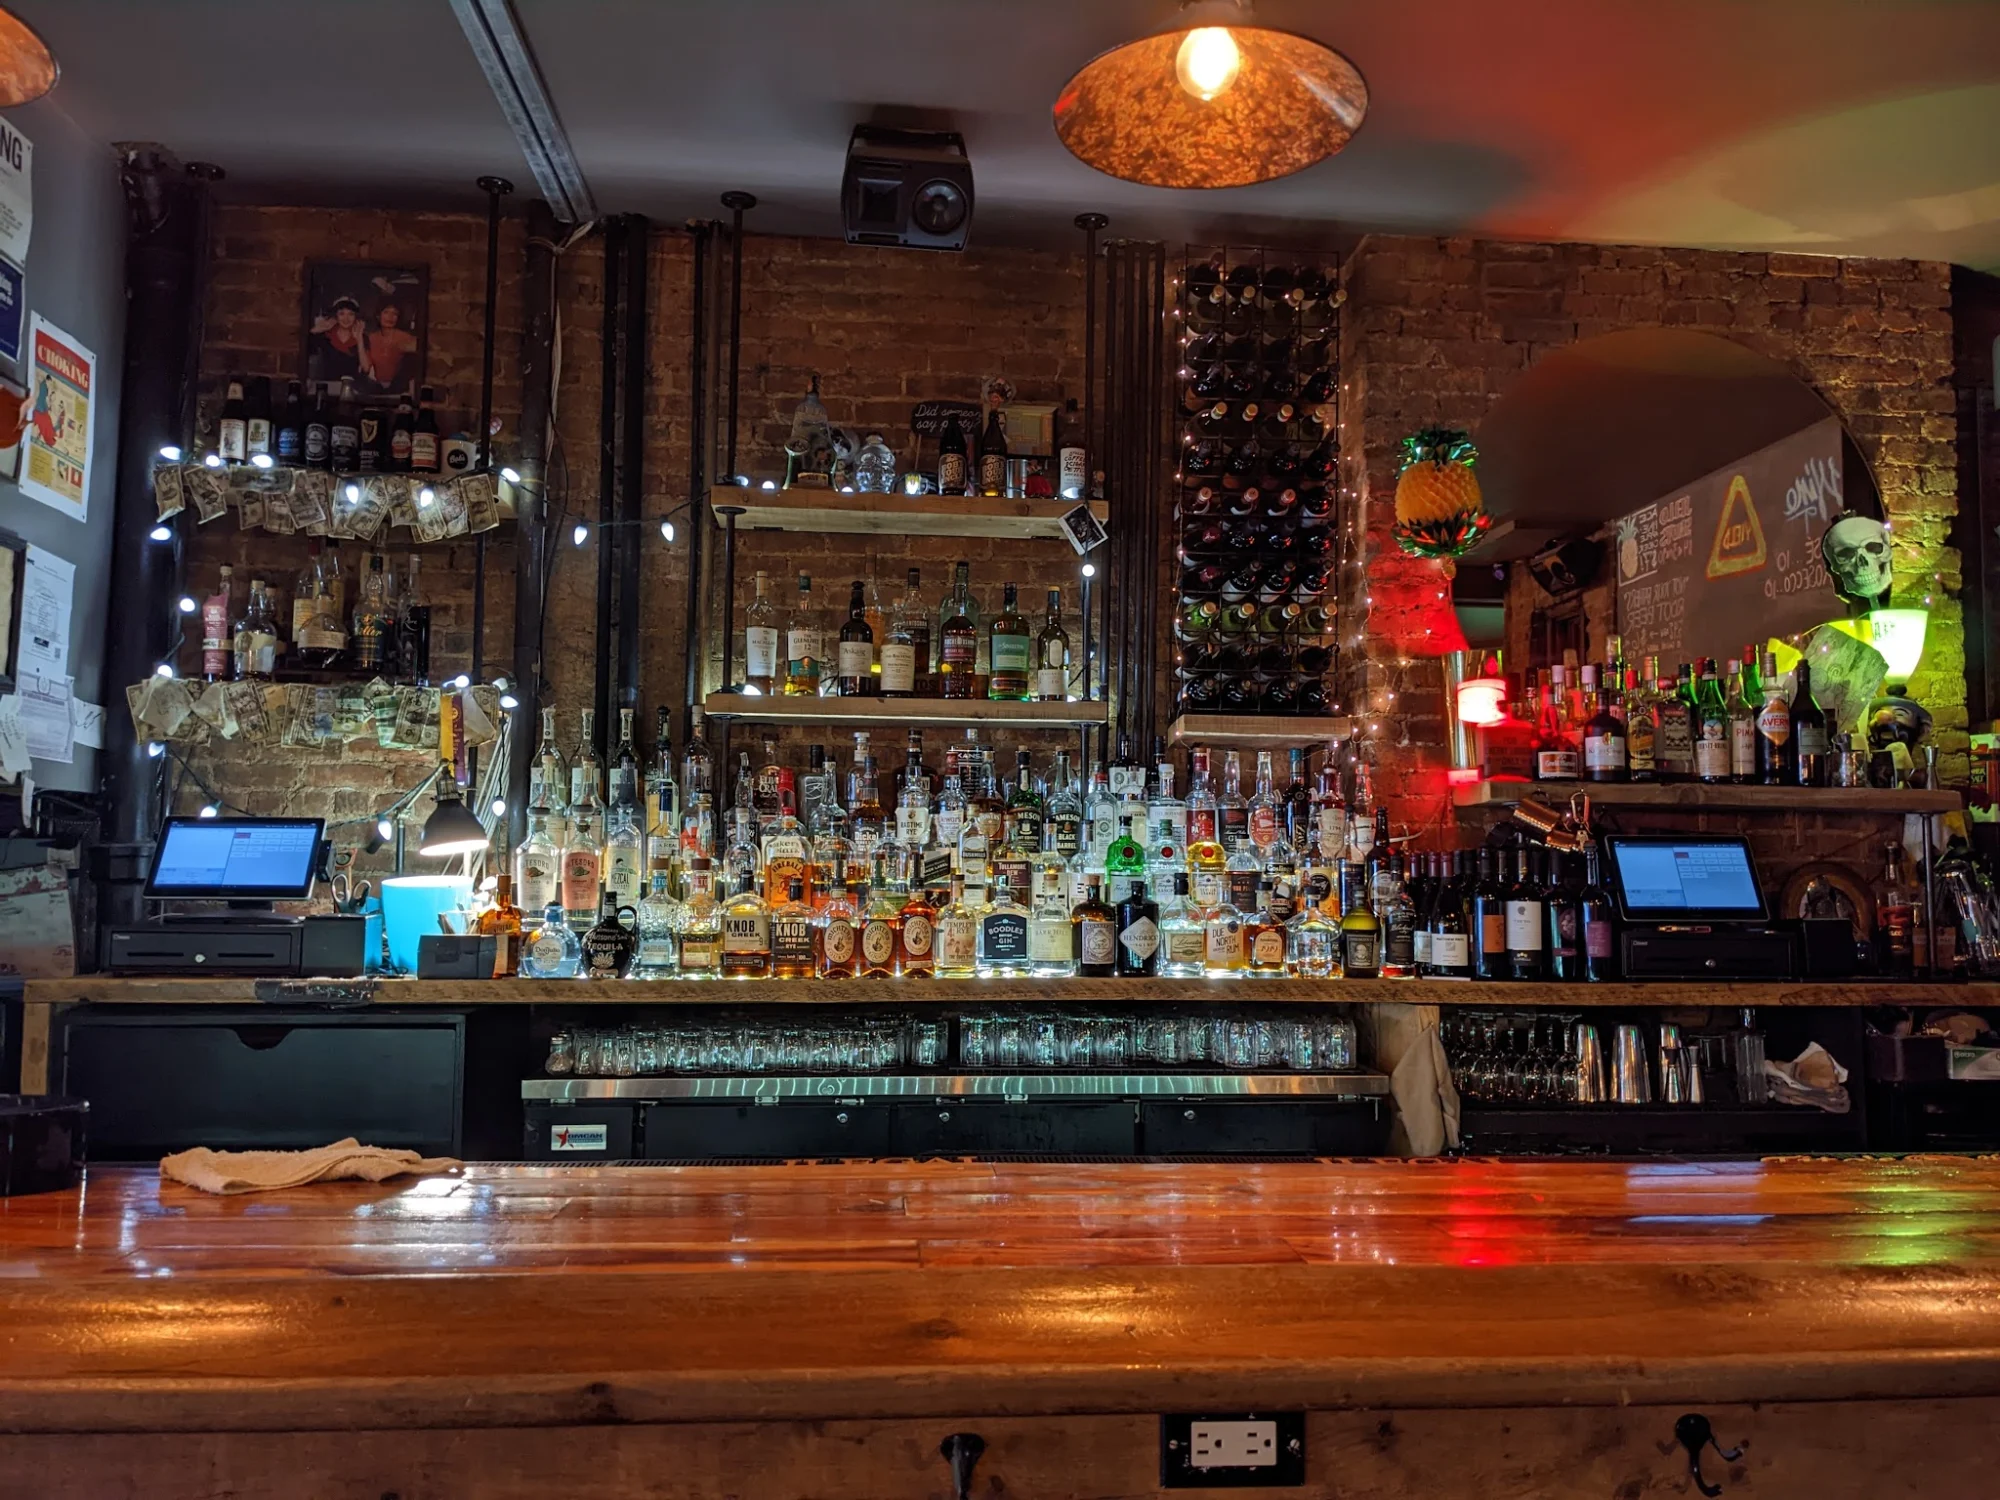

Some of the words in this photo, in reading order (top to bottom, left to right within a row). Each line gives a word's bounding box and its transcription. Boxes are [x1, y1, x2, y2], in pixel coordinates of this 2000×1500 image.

[37, 343, 89, 389] CHOKING
[915, 404, 940, 417] Did
[915, 420, 937, 433] say
[803, 643, 812, 651] 12
[854, 831, 879, 840] Dickel
[772, 860, 804, 874] FIREBALL
[726, 919, 755, 933] KNOB
[775, 923, 806, 937] KNOB
[988, 926, 1024, 935] BOODLES
[1212, 927, 1225, 938] DUE
[587, 942, 623, 950] TEQUILA
[1215, 937, 1237, 947] NORTH
[1226, 944, 1240, 954] RUM
